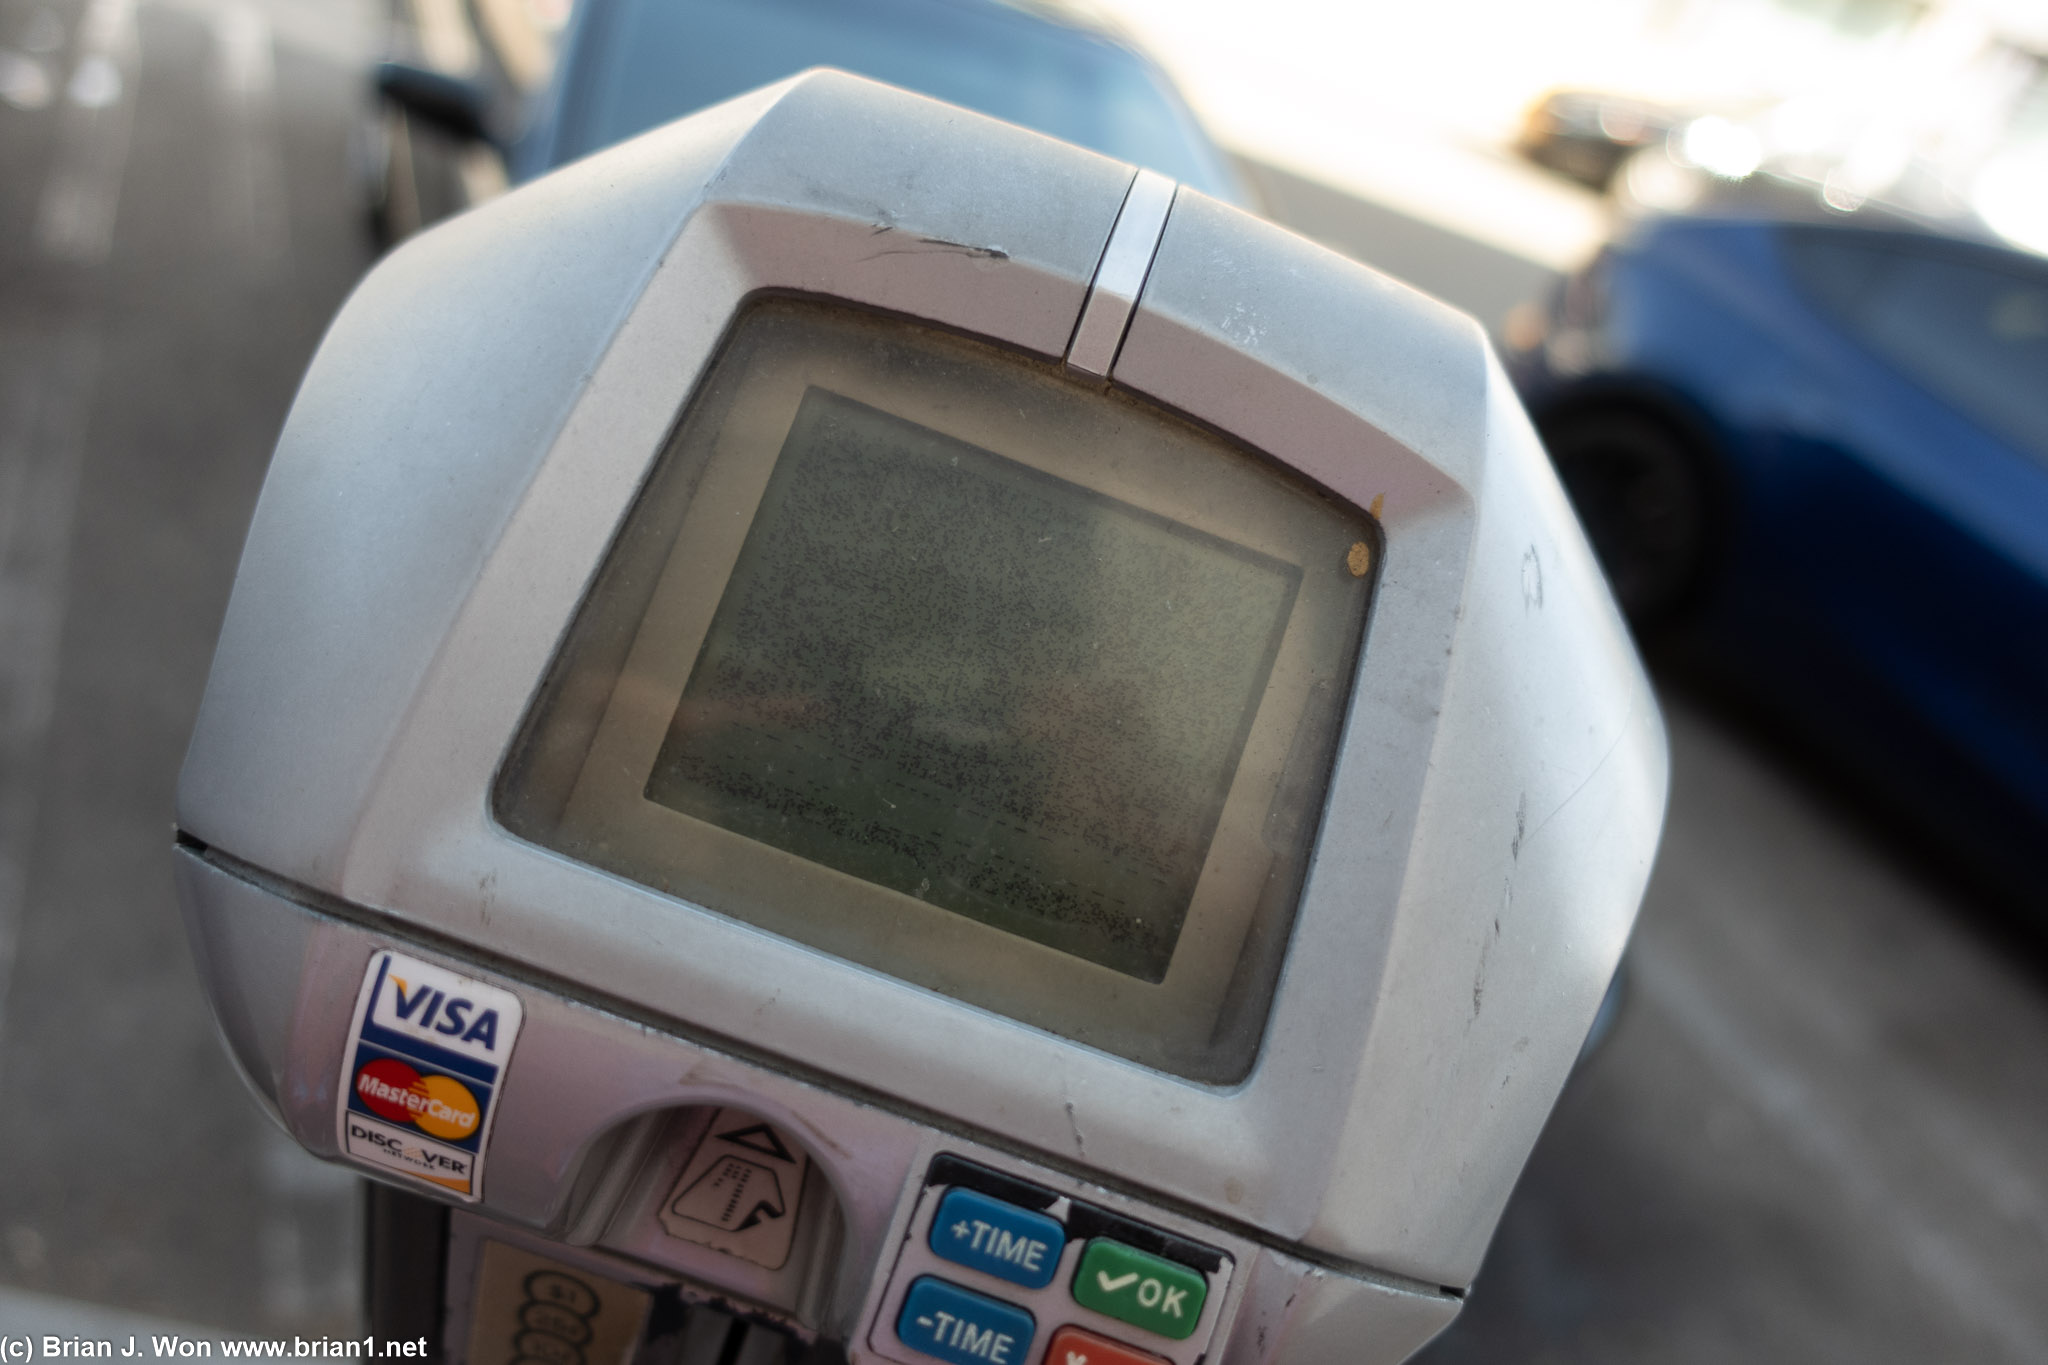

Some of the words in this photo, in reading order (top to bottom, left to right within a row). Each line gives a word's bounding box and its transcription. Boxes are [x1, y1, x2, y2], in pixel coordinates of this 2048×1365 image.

[388, 974, 499, 1051] VISA
[358, 1073, 476, 1128] MasterCard
[951, 1219, 1048, 1272] +TIME
[1137, 1277, 1188, 1319] OK
[916, 1310, 1015, 1364] -TIME
